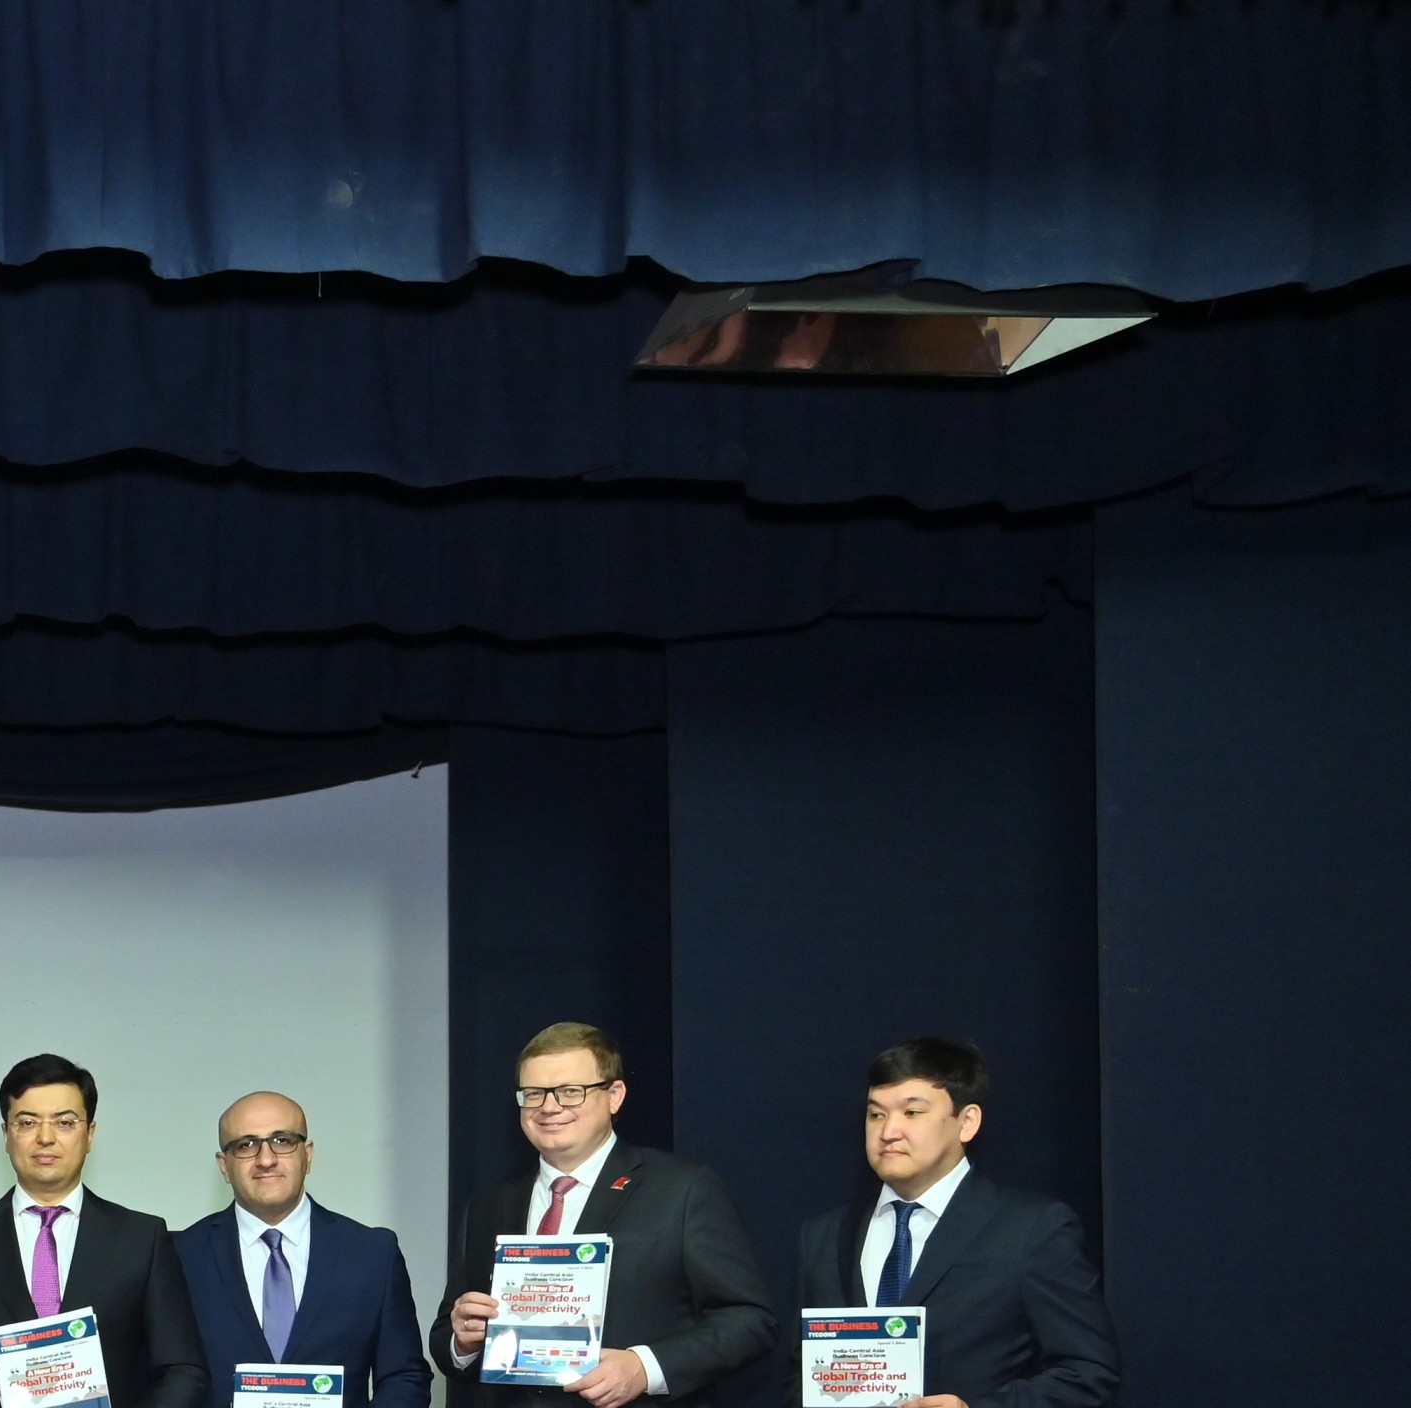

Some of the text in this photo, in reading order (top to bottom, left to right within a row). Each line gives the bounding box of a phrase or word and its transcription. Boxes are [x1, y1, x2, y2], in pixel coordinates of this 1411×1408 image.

[511, 1304, 581, 1314] Connectivity
[808, 1322, 879, 1331] THE BUSINESS
[20, 1329, 63, 1344] BUSINESS
[44, 1368, 92, 1383] Trade and
[812, 1372, 906, 1380] Global Trade and
[261, 1378, 306, 1386] BUSINESS
[823, 1383, 897, 1393] Connectivity
